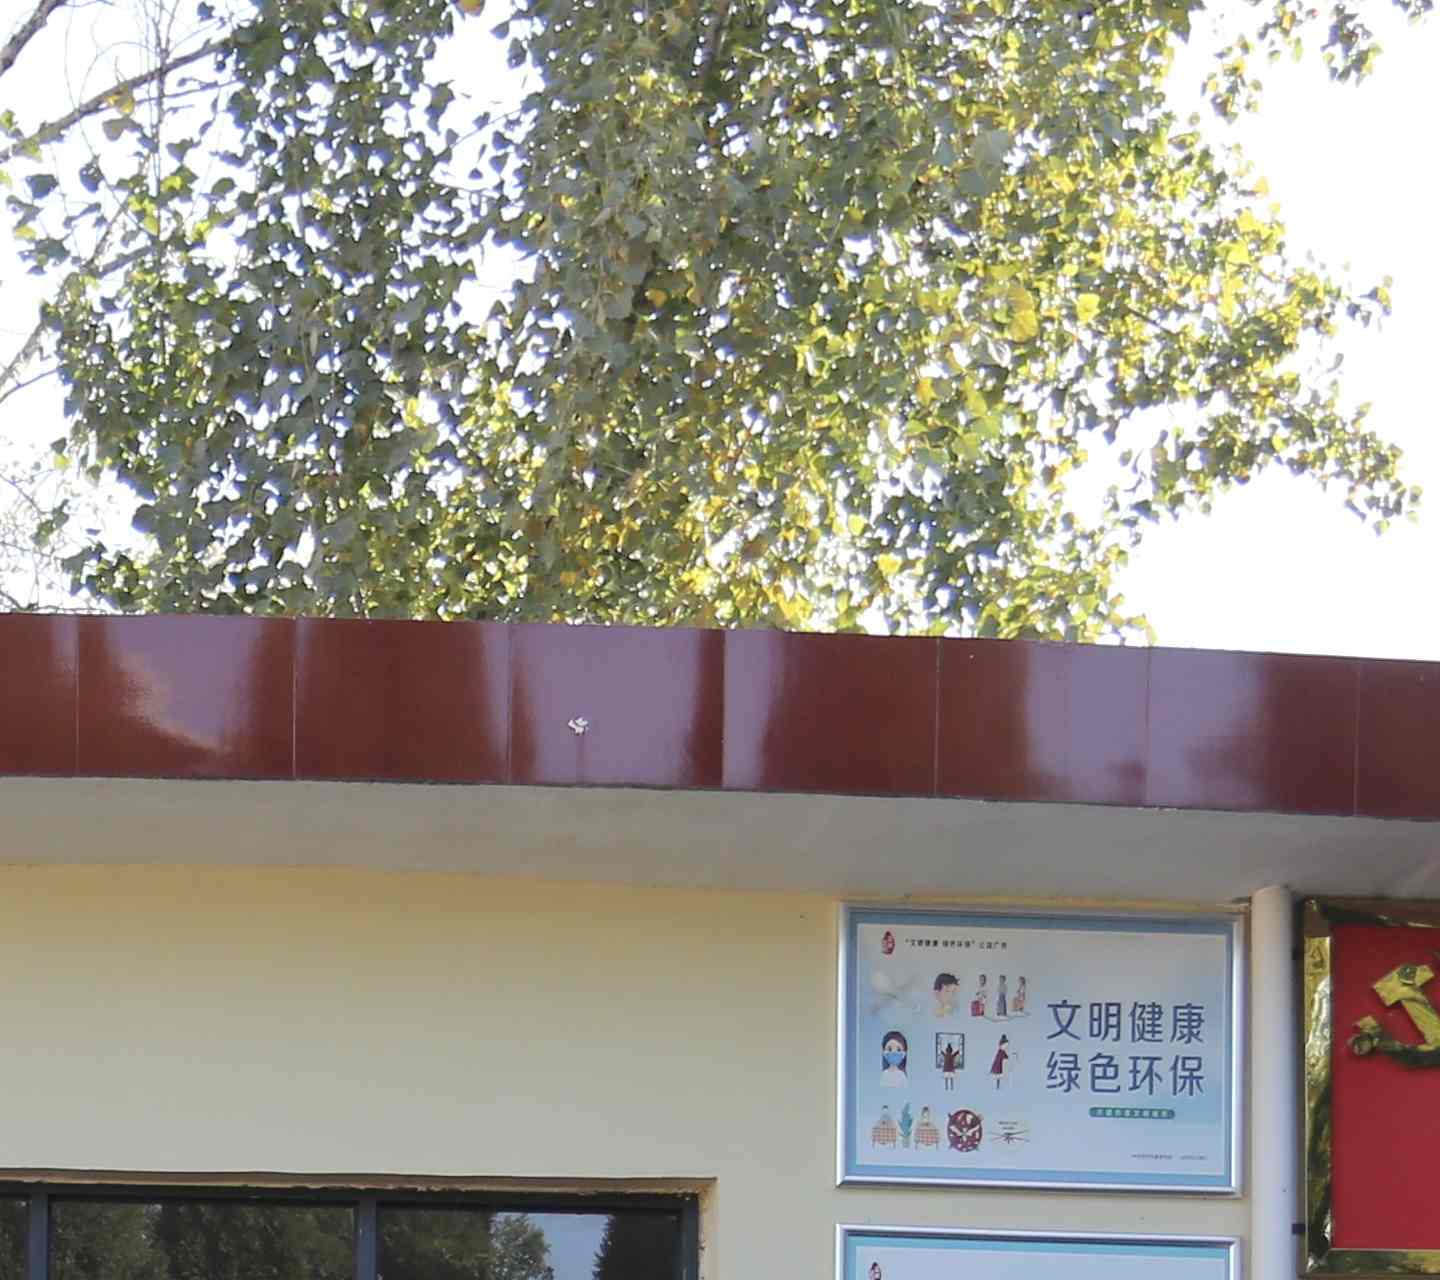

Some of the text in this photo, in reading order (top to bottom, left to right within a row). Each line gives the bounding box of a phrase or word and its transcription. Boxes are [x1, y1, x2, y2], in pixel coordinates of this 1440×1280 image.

[1047, 1000, 1205, 1044] 文明健康
[1046, 1051, 1205, 1096] 绿色环保
